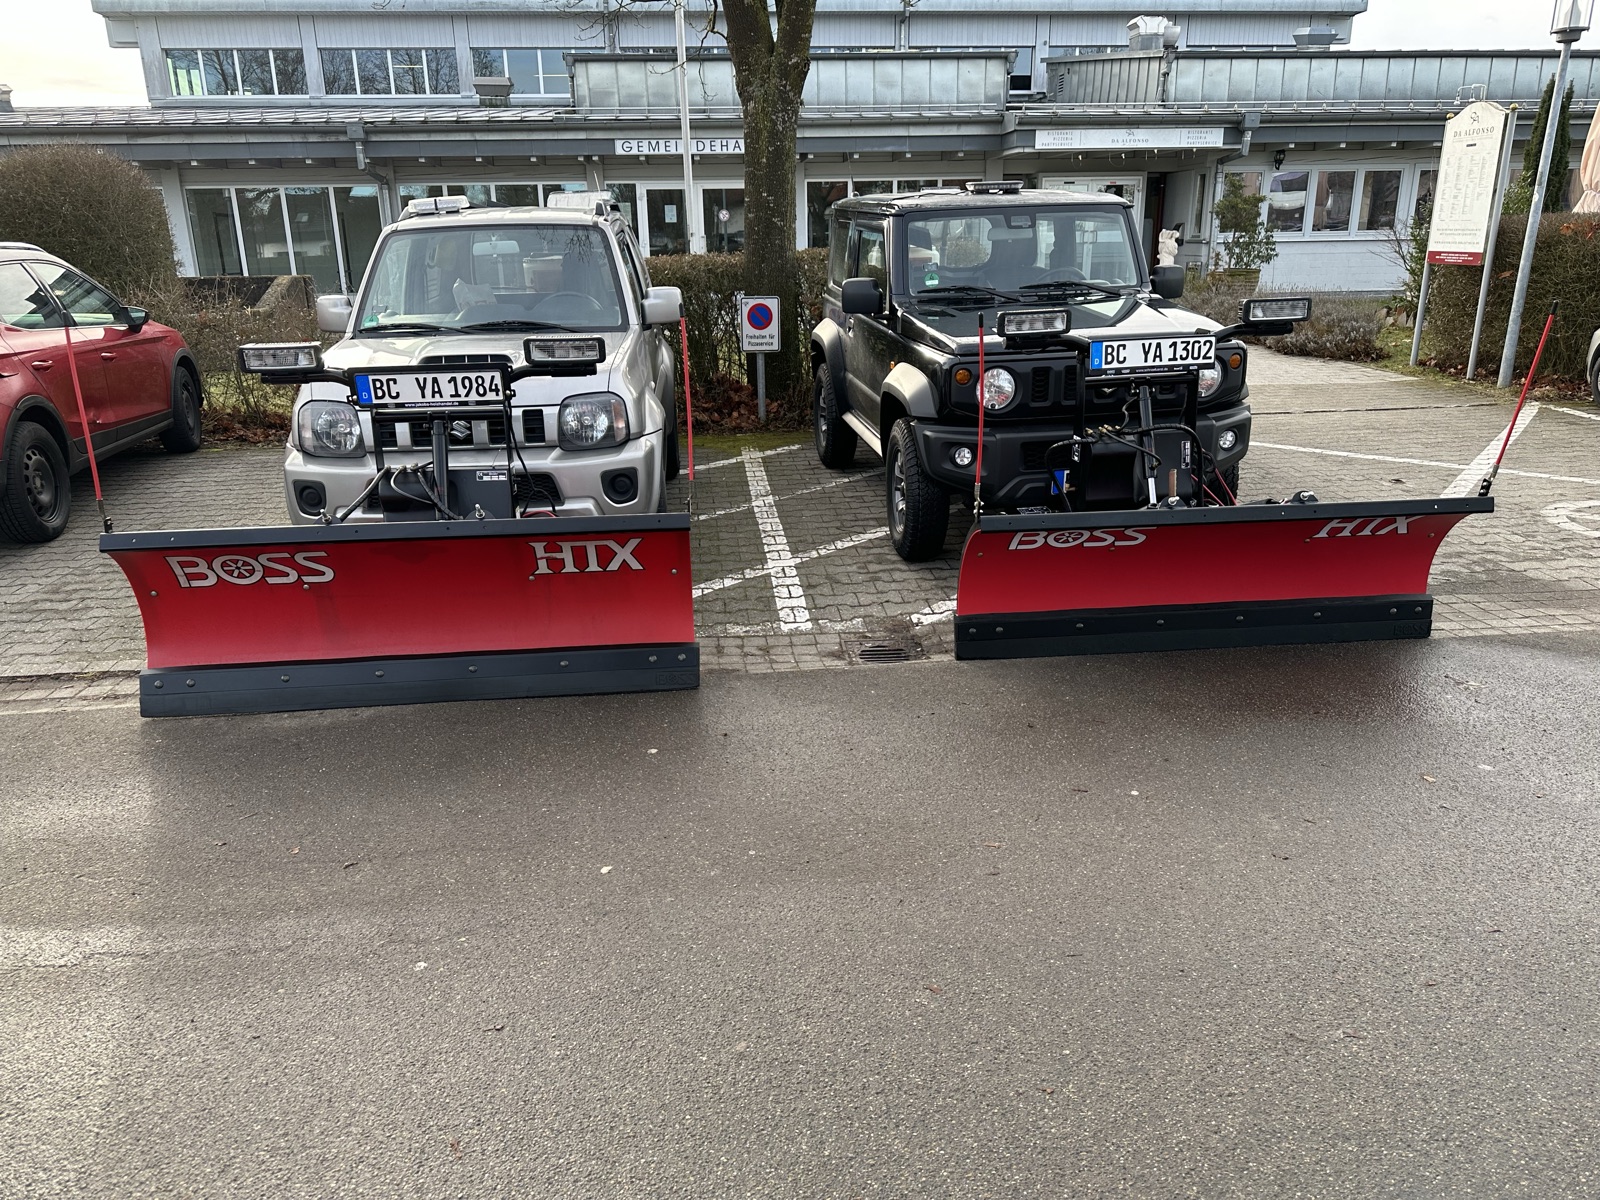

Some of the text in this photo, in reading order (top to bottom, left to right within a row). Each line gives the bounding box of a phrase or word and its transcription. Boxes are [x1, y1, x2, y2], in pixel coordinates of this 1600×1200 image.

[1453, 126, 1495, 138] DA ALFONSO
[621, 140, 742, 152] GEMEIDEHA
[1104, 344, 1127, 366] BC
[1141, 342, 1163, 363] YA
[1167, 340, 1214, 362] 1302
[371, 378, 400, 400] BC
[414, 376, 444, 399] YA
[447, 375, 501, 398] 1984
[1008, 527, 1158, 551] BOSS
[527, 537, 646, 575] HTX
[164, 551, 335, 588] BOSS
